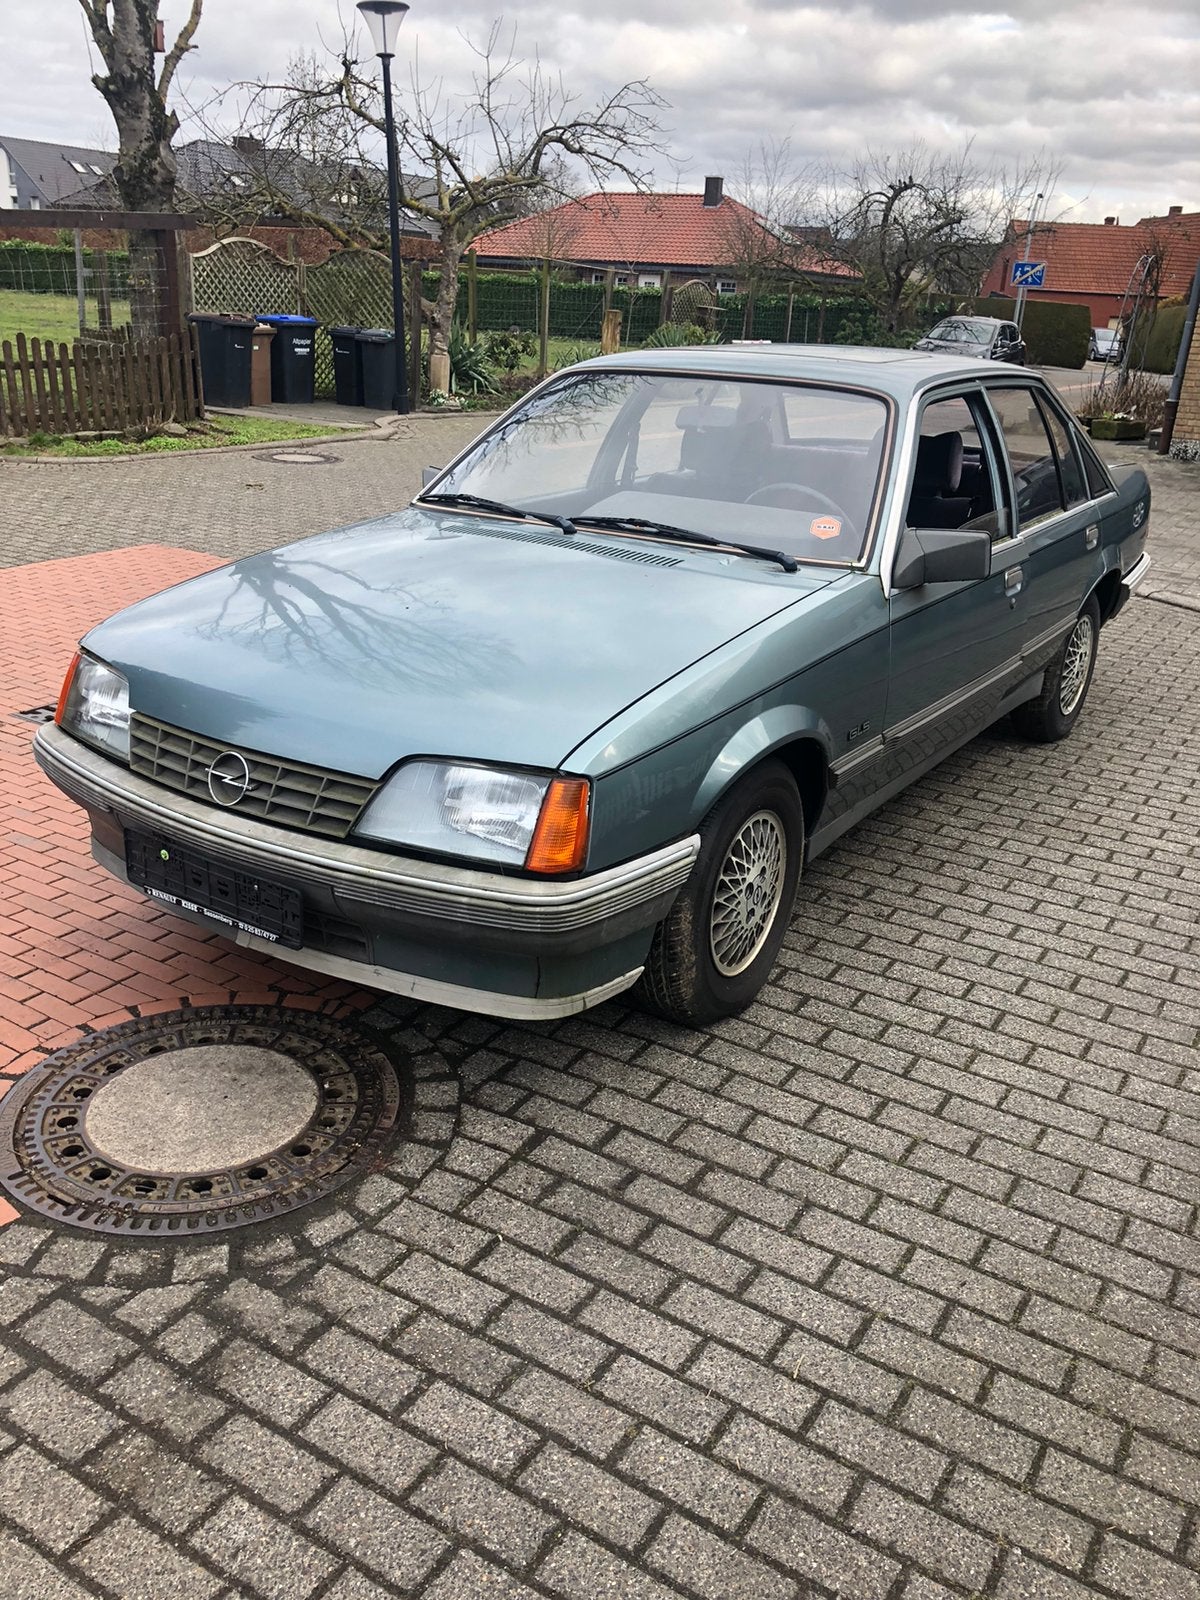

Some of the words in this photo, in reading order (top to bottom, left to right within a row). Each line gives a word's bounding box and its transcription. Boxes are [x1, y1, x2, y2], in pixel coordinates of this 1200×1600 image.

[292, 337, 311, 345] Altpapier
[849, 720, 870, 740] GLS
[151, 888, 176, 904] RENAULT
